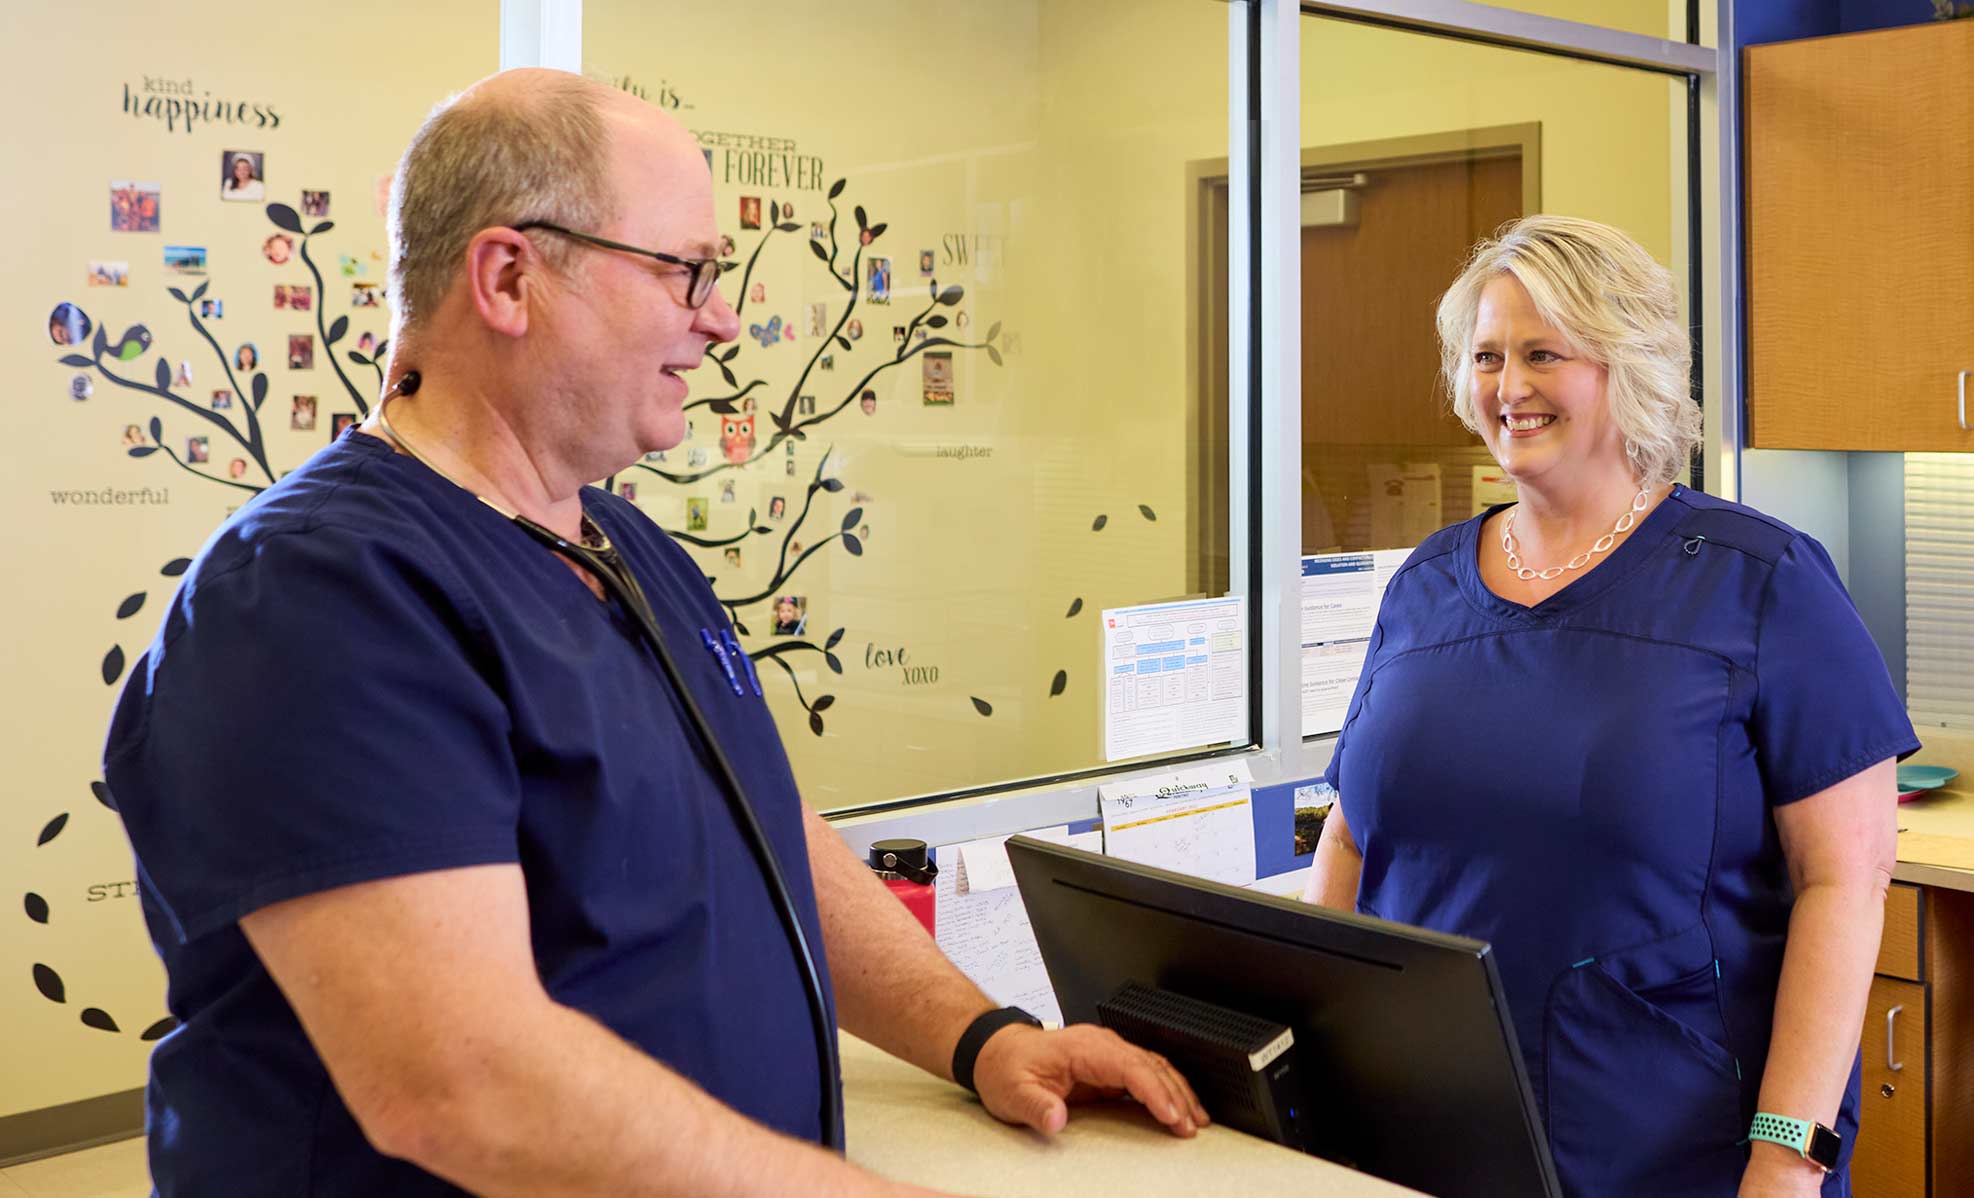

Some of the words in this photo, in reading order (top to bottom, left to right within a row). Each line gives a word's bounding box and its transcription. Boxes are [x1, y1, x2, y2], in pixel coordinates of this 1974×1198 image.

[144, 76, 193, 95] kind
[123, 82, 280, 133] happiness
[689, 129, 797, 152] OGETHER
[725, 149, 823, 191] FOREVER
[936, 444, 993, 461] laughter
[50, 487, 169, 506] wonderful
[865, 642, 910, 669] love
[1155, 781, 1209, 799] Quickway
